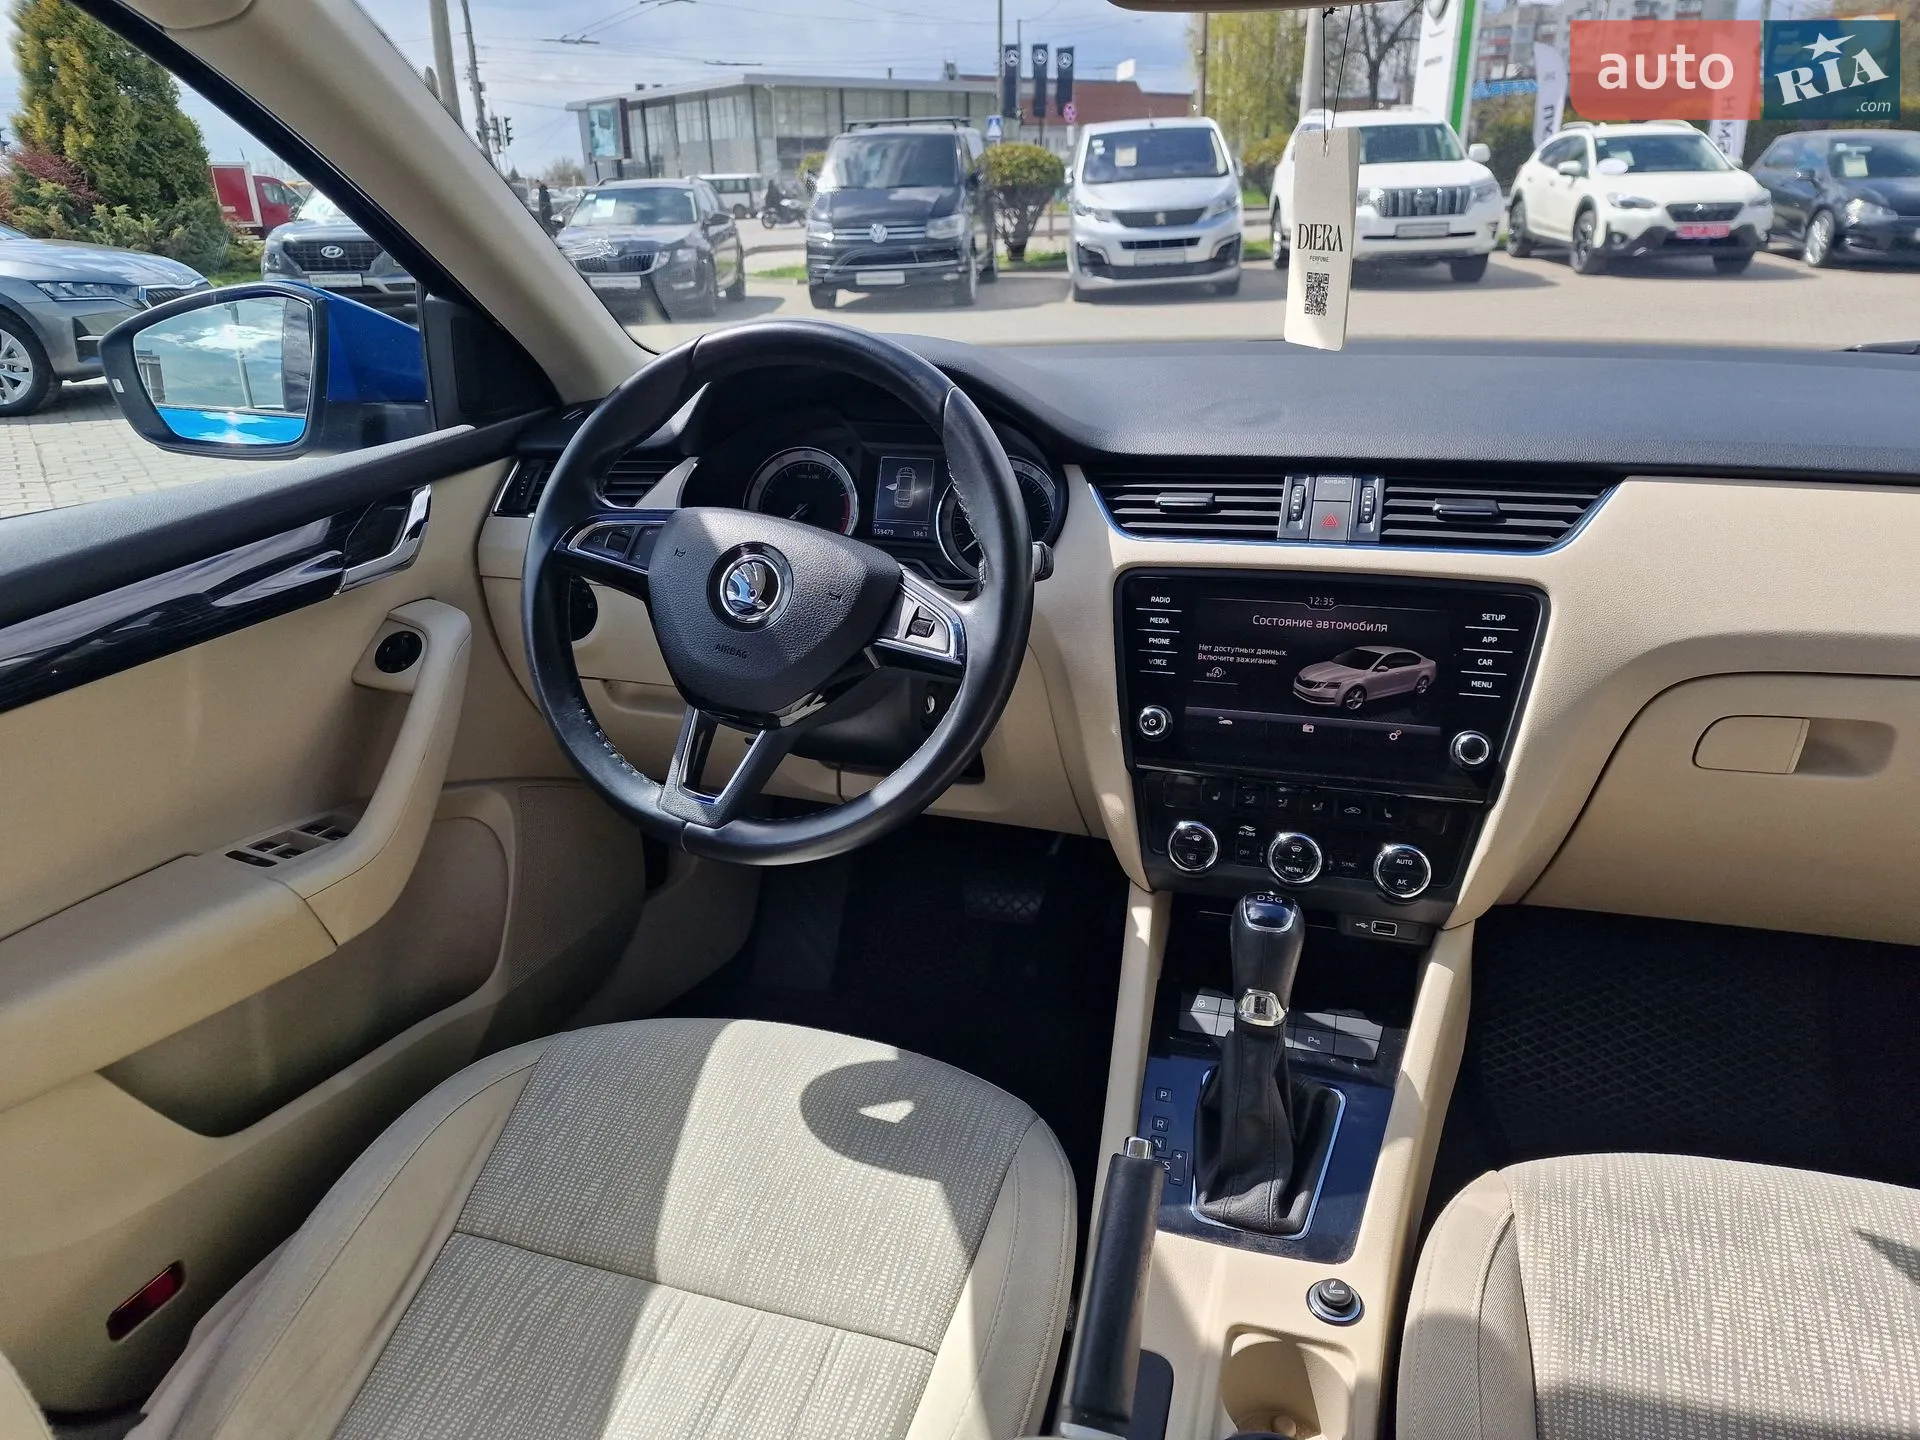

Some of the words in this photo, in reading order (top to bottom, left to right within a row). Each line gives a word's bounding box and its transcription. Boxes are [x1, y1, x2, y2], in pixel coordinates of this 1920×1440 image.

[1297, 223, 1343, 252] DIERA
[1309, 255, 1330, 263] PERFUME
[1150, 596, 1171, 604] RADIO
[1308, 596, 1335, 606] 12:35
[1149, 616, 1170, 624] MEDIA
[1481, 613, 1506, 621] SETUP
[1252, 614, 1313, 628] Состояние
[1316, 620, 1388, 632] автомобиля
[1148, 637, 1171, 645] PHONE
[715, 643, 748, 659] AIRBAG
[1198, 643, 1212, 651] Нет
[1213, 645, 1255, 654] доступных
[1256, 648, 1288, 656] данных.
[1148, 658, 1167, 666] VOICE
[1197, 652, 1235, 663] Включите
[1235, 656, 1278, 665] зажигание.
[1477, 658, 1493, 666] CAR
[1471, 680, 1493, 689] MENU
[1396, 858, 1413, 866] AUTO
[1285, 866, 1304, 874] MENU
[1257, 894, 1283, 904] DSG
[1160, 1090, 1168, 1099] P
[1156, 1119, 1165, 1129] R
